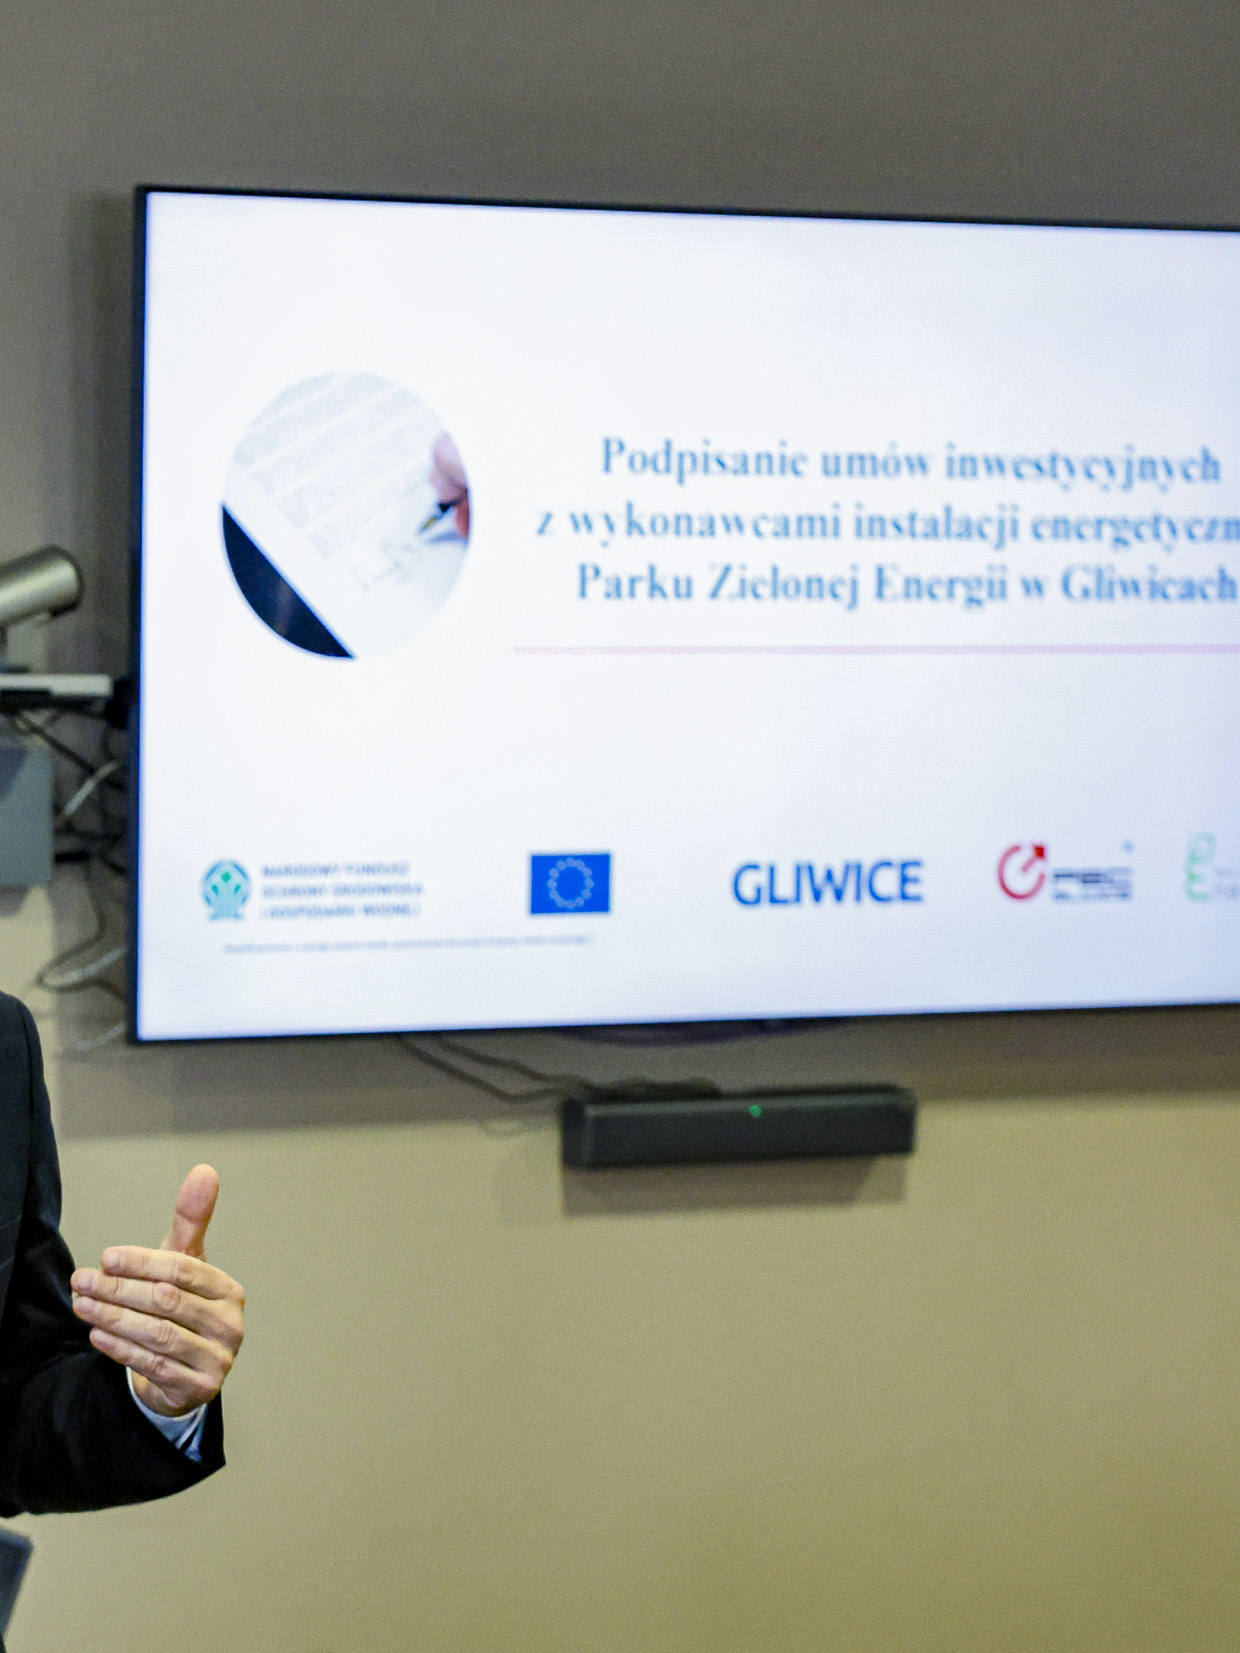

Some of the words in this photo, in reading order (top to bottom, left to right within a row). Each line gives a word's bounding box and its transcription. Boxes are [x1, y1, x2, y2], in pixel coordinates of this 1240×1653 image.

[602, 437, 809, 486] Podpisanie
[821, 440, 929, 479] umów
[945, 442, 1221, 491] inwestycyjnych
[537, 512, 555, 536] z
[568, 500, 842, 547] wykonawcami
[855, 502, 1020, 549] instalacji
[578, 563, 693, 600] Parku
[709, 563, 859, 612] Zielonej
[875, 563, 1009, 609] Energii
[1020, 575, 1046, 599] w
[1061, 563, 1239, 601] Gliwicach
[732, 858, 924, 908] GLIWICE
